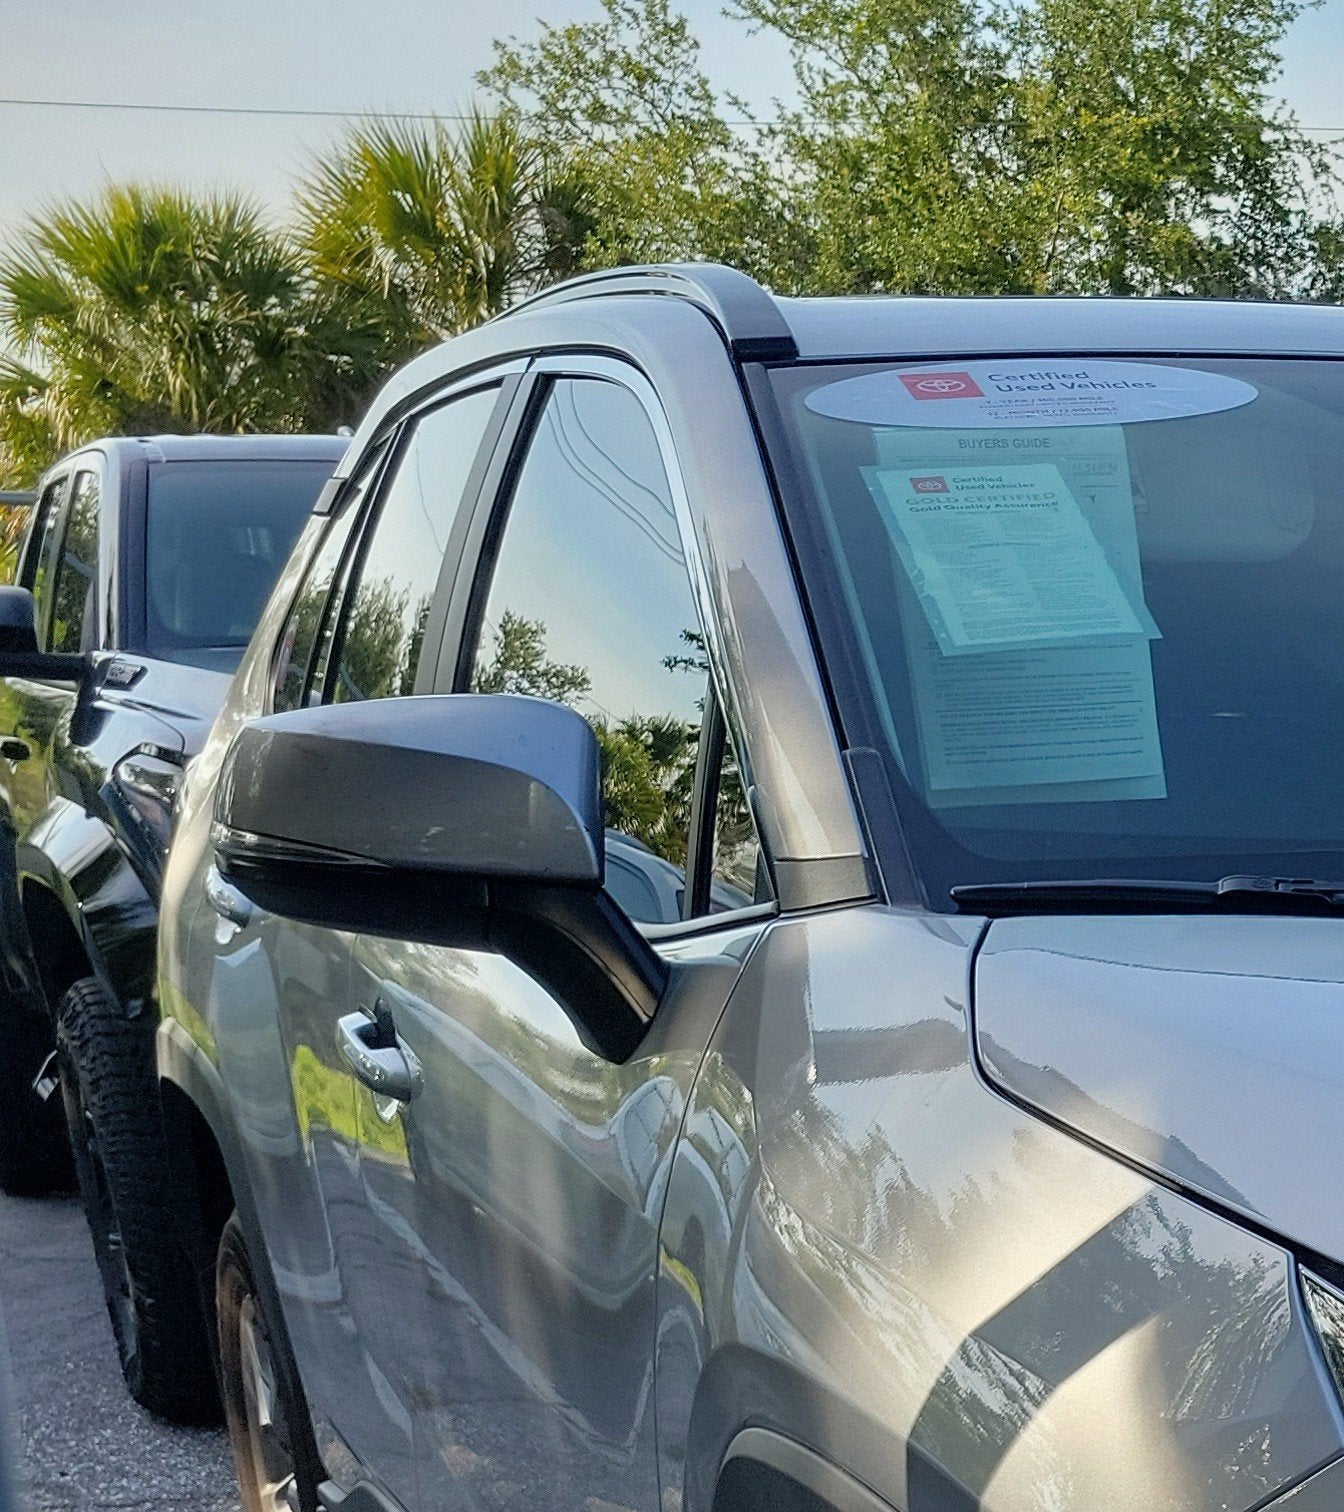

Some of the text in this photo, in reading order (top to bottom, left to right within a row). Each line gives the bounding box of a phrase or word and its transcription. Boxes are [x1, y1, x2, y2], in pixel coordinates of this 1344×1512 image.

[988, 371, 1089, 381] Certified
[995, 381, 1156, 392] Used Vehicles
[958, 438, 1051, 449] BUYERS GUIDE
[906, 492, 1055, 505] GOLD CERTIFIED
